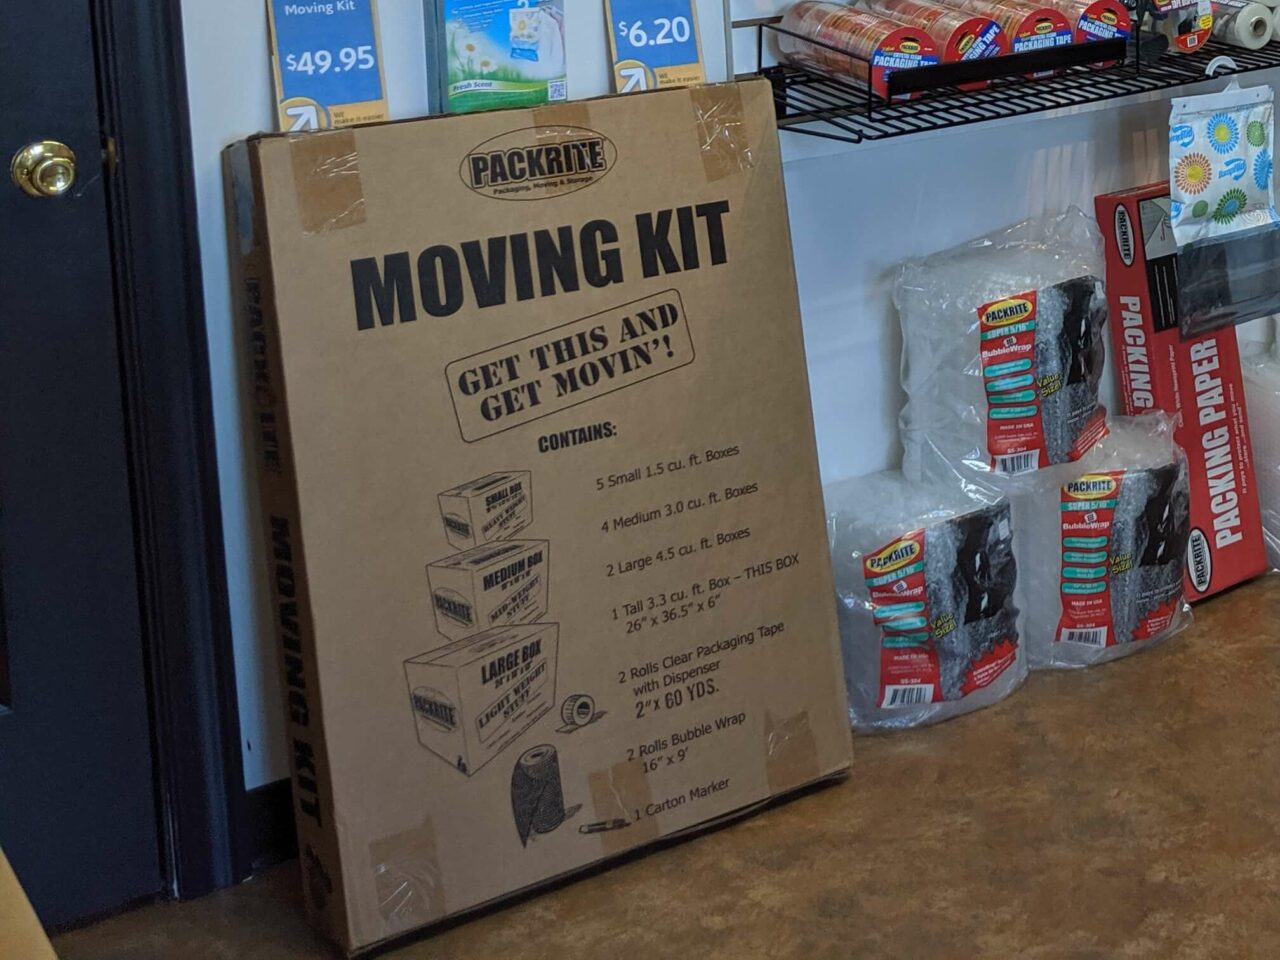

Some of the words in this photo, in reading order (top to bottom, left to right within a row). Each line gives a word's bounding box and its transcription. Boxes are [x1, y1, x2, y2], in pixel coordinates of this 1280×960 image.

[285, 2, 332, 16] Moving
[336, 0, 356, 11] Kit
[619, 17, 690, 47] $6.20
[286, 46, 374, 75] $49.95
[874, 56, 917, 68] PACKAGING
[452, 83, 474, 93] Fresh
[470, 138, 605, 187] PACKRITE
[351, 219, 624, 331] MOVING
[636, 200, 730, 278] KIT
[985, 302, 1028, 322] PACKRITE
[458, 355, 520, 396] GET
[530, 326, 608, 371] THIS
[619, 303, 678, 338] AND
[982, 343, 1032, 359] BubbleWrap
[1120, 295, 1153, 409] PACKING
[481, 380, 541, 422] GET
[1190, 338, 1226, 431] PAPER
[538, 421, 617, 453] CONTAINS:
[596, 478, 604, 490] 5
[608, 470, 641, 488] Small
[646, 464, 664, 478] 1.5
[668, 460, 685, 472] cu.
[689, 453, 703, 466] ft.
[706, 445, 739, 462] Boxes
[1067, 479, 1112, 493] PACKRITE
[1201, 428, 1243, 549] PACKING
[602, 521, 608, 533] 4
[613, 509, 661, 530] Medium
[665, 502, 684, 517] 3.0
[688, 497, 705, 509] cu.
[709, 491, 722, 503] ft.
[725, 482, 758, 500] Boxes
[483, 559, 525, 591] MEDIUM
[527, 550, 543, 571] BOX
[607, 565, 614, 576] 2
[619, 555, 652, 575] Large
[656, 547, 675, 561] 4.5
[679, 542, 696, 555] cu.
[701, 536, 714, 549] ft.
[717, 528, 750, 545] Boxes
[870, 543, 916, 568] PACKRITE
[612, 608, 618, 620] 1
[623, 599, 643, 616] Tall
[648, 594, 667, 609] 3.3
[671, 589, 688, 602] cu.
[692, 583, 705, 596] ft.
[709, 575, 730, 591] Box
[744, 562, 772, 581] THIS
[776, 553, 799, 572] BOX
[481, 647, 521, 685] LARGE
[522, 639, 542, 664] BOX
[619, 672, 626, 683] 2
[630, 662, 659, 679] Rolls
[663, 650, 693, 669] Clear
[697, 632, 754, 662] Packaging
[757, 621, 785, 638] Tape
[634, 679, 659, 696] with
[664, 660, 720, 686] Dispenser
[665, 691, 683, 708] 60
[689, 678, 719, 702] YDS.
[627, 749, 634, 760] 2
[640, 739, 668, 757] Rolls
[672, 724, 712, 746] Bubble
[715, 711, 746, 732] Wrap
[635, 810, 641, 820] 1
[646, 795, 686, 816] Carton
[690, 777, 730, 798] Marker
